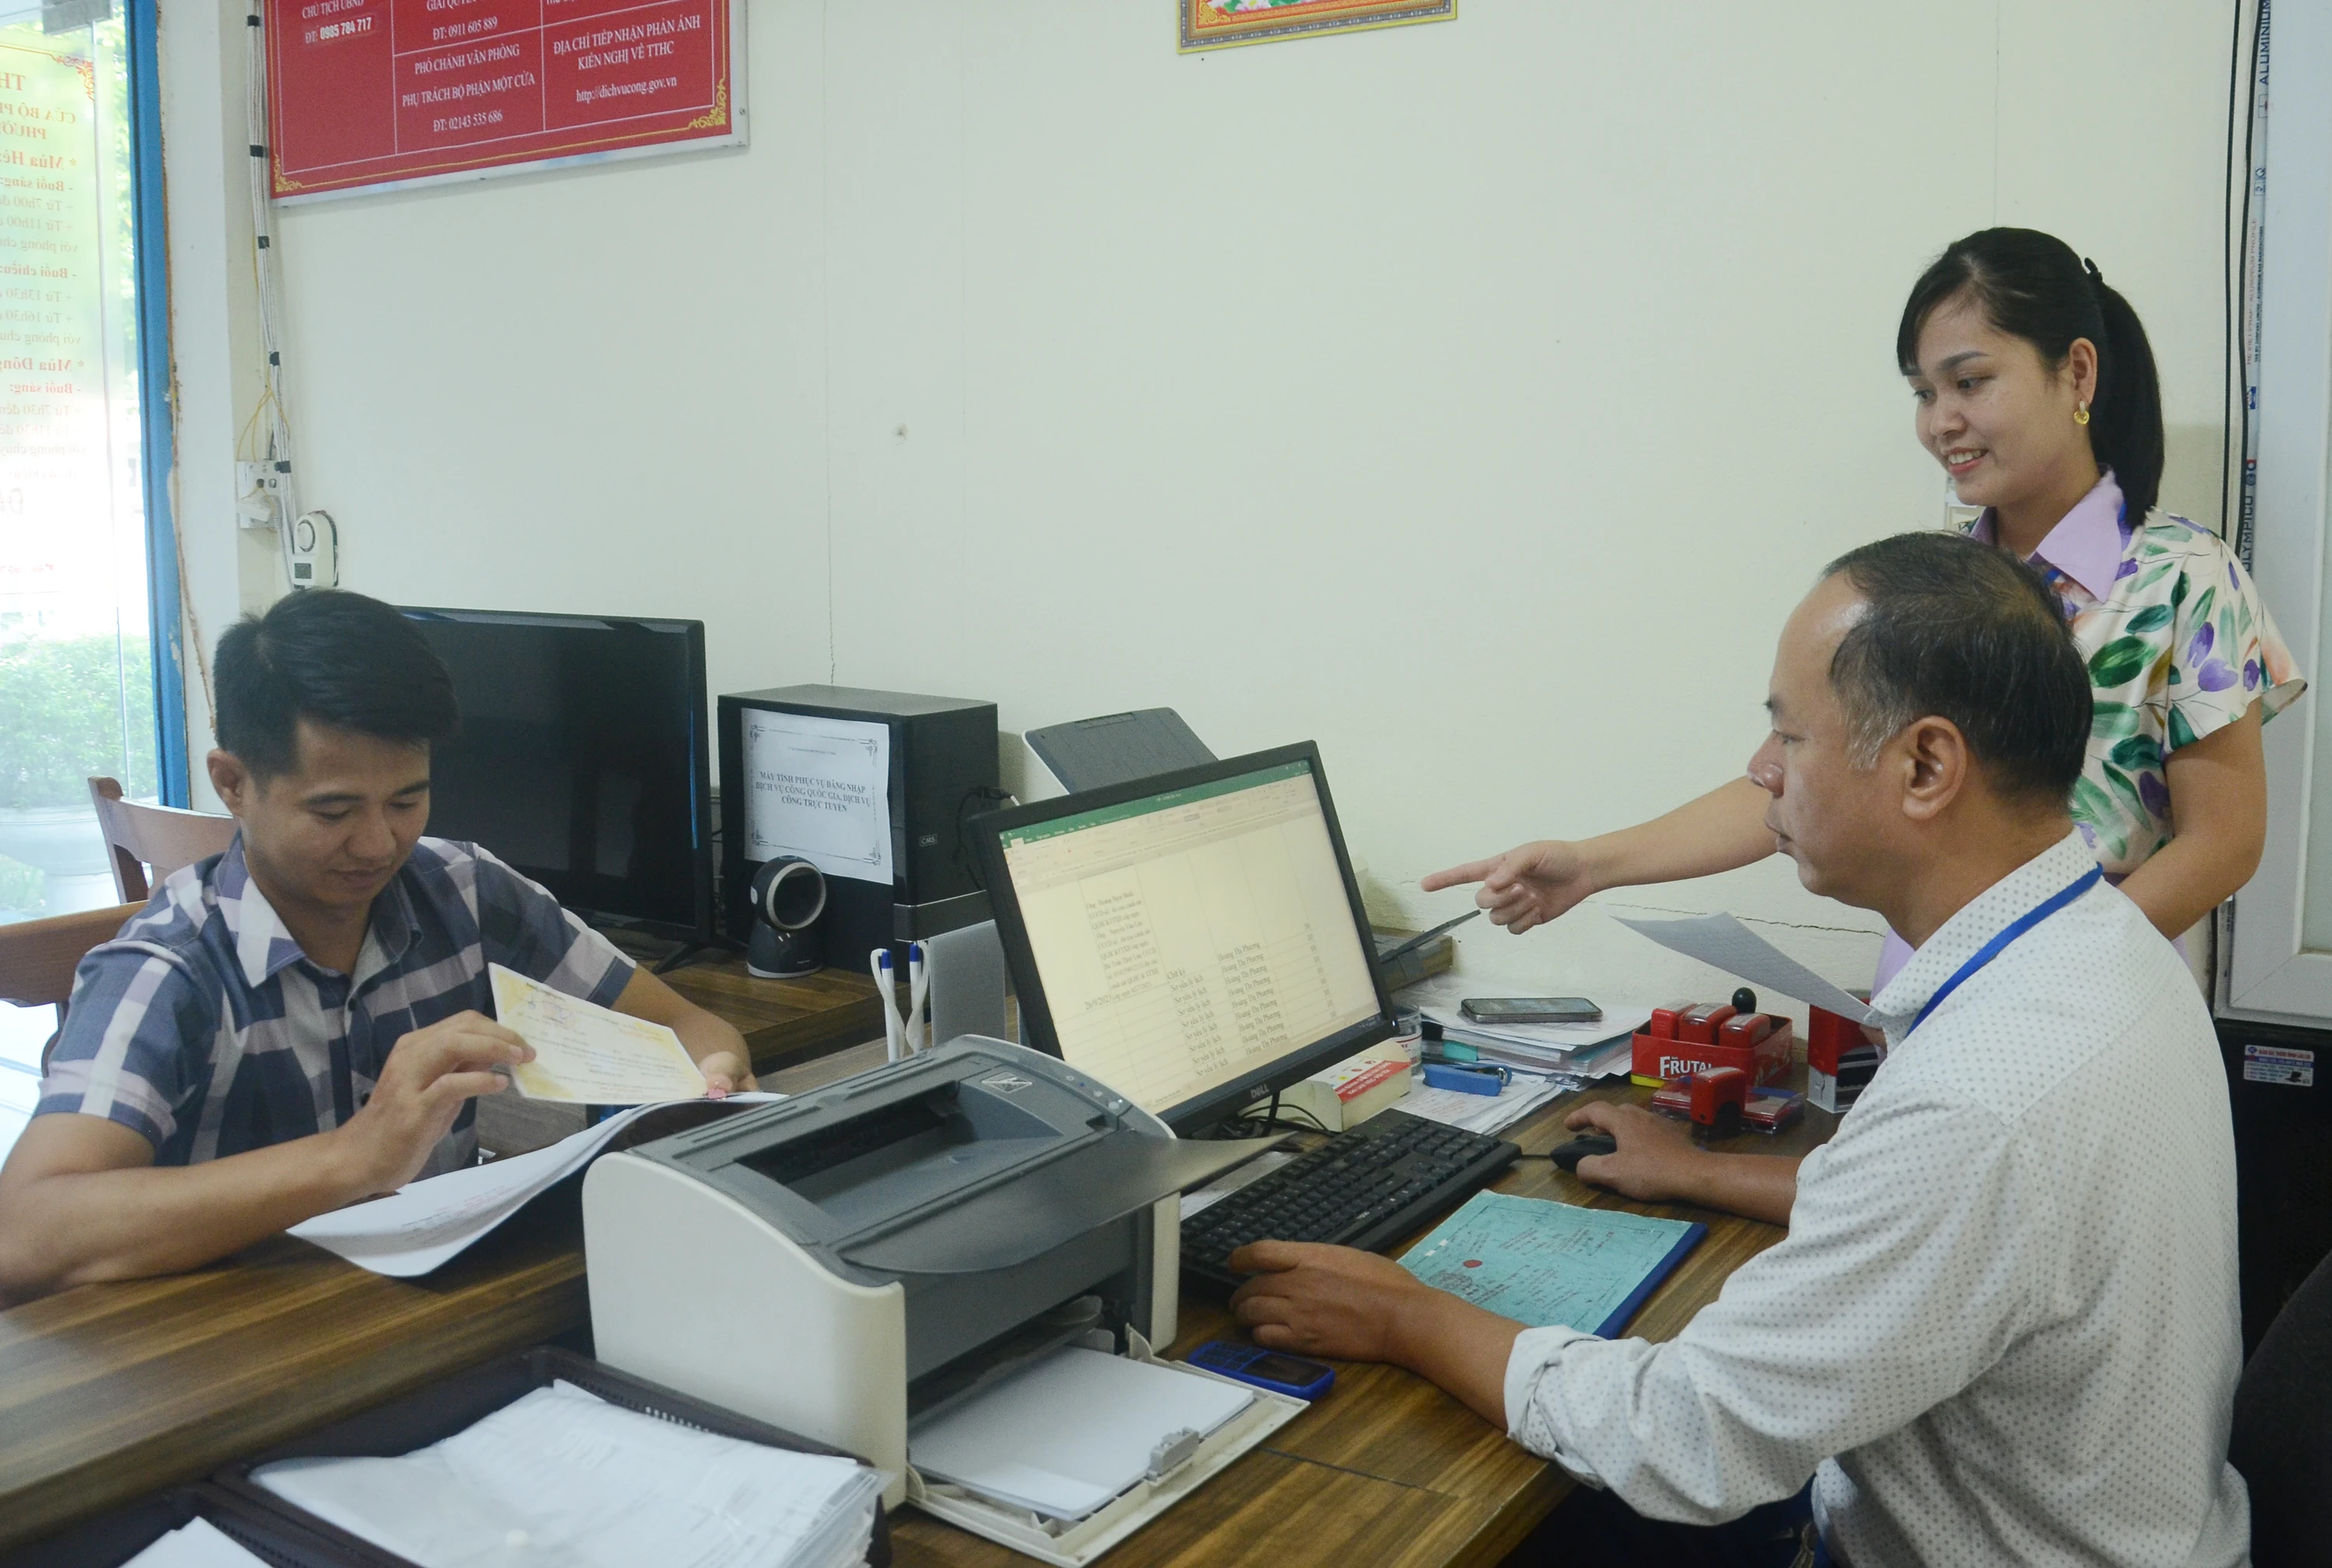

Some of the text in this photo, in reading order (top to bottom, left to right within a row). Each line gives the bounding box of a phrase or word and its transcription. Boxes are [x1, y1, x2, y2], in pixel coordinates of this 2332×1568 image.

[302, 2, 319, 19] CHỦ
[357, 17, 372, 32] 717
[433, 16, 497, 40] ĐT: 0911 605 889
[553, 40, 570, 55] ĐỊA
[572, 31, 590, 51] CHỈ
[592, 28, 613, 47] TIẾP
[615, 25, 644, 44] NHẬN
[677, 14, 700, 32] ÁNH
[578, 40, 675, 71] KIẾN NGHỊ VỀ TTHC
[2259, 0, 2270, 85] ALUMINIUM
[434, 54, 465, 72] CHÁNH
[466, 49, 487, 65] VĂN
[488, 43, 520, 61] PHÒNG
[402, 71, 536, 107] PHỤ TRÁCH BỘ PHẬN MỘT CỬA
[576, 76, 677, 104] http://dichvucong.gov.vn
[433, 110, 503, 132] ĐT: 02143 535 686
[1251, 1084, 1270, 1099] DELL
